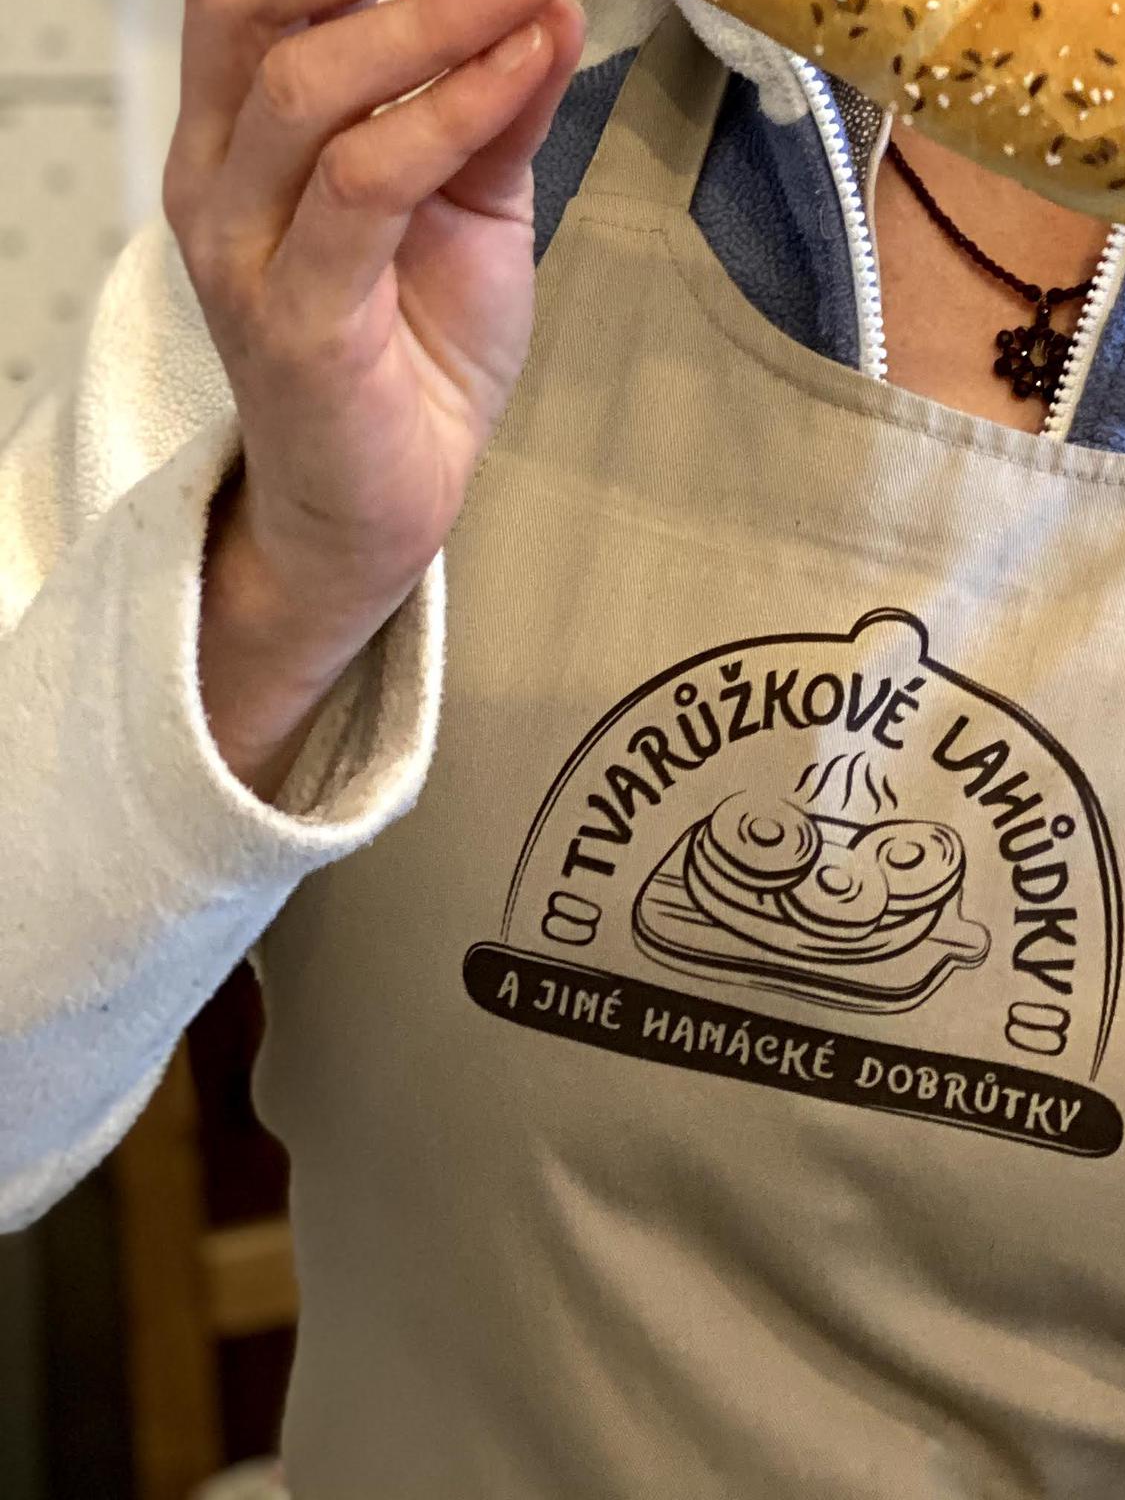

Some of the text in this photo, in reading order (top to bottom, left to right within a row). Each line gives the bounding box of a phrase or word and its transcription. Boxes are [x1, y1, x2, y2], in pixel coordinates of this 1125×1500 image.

[562, 660, 1078, 996] TVARŮŽKOVÉ LAHŮDKY
[497, 970, 518, 1008] A
[855, 1056, 1081, 1135] DOBRŮTKY
